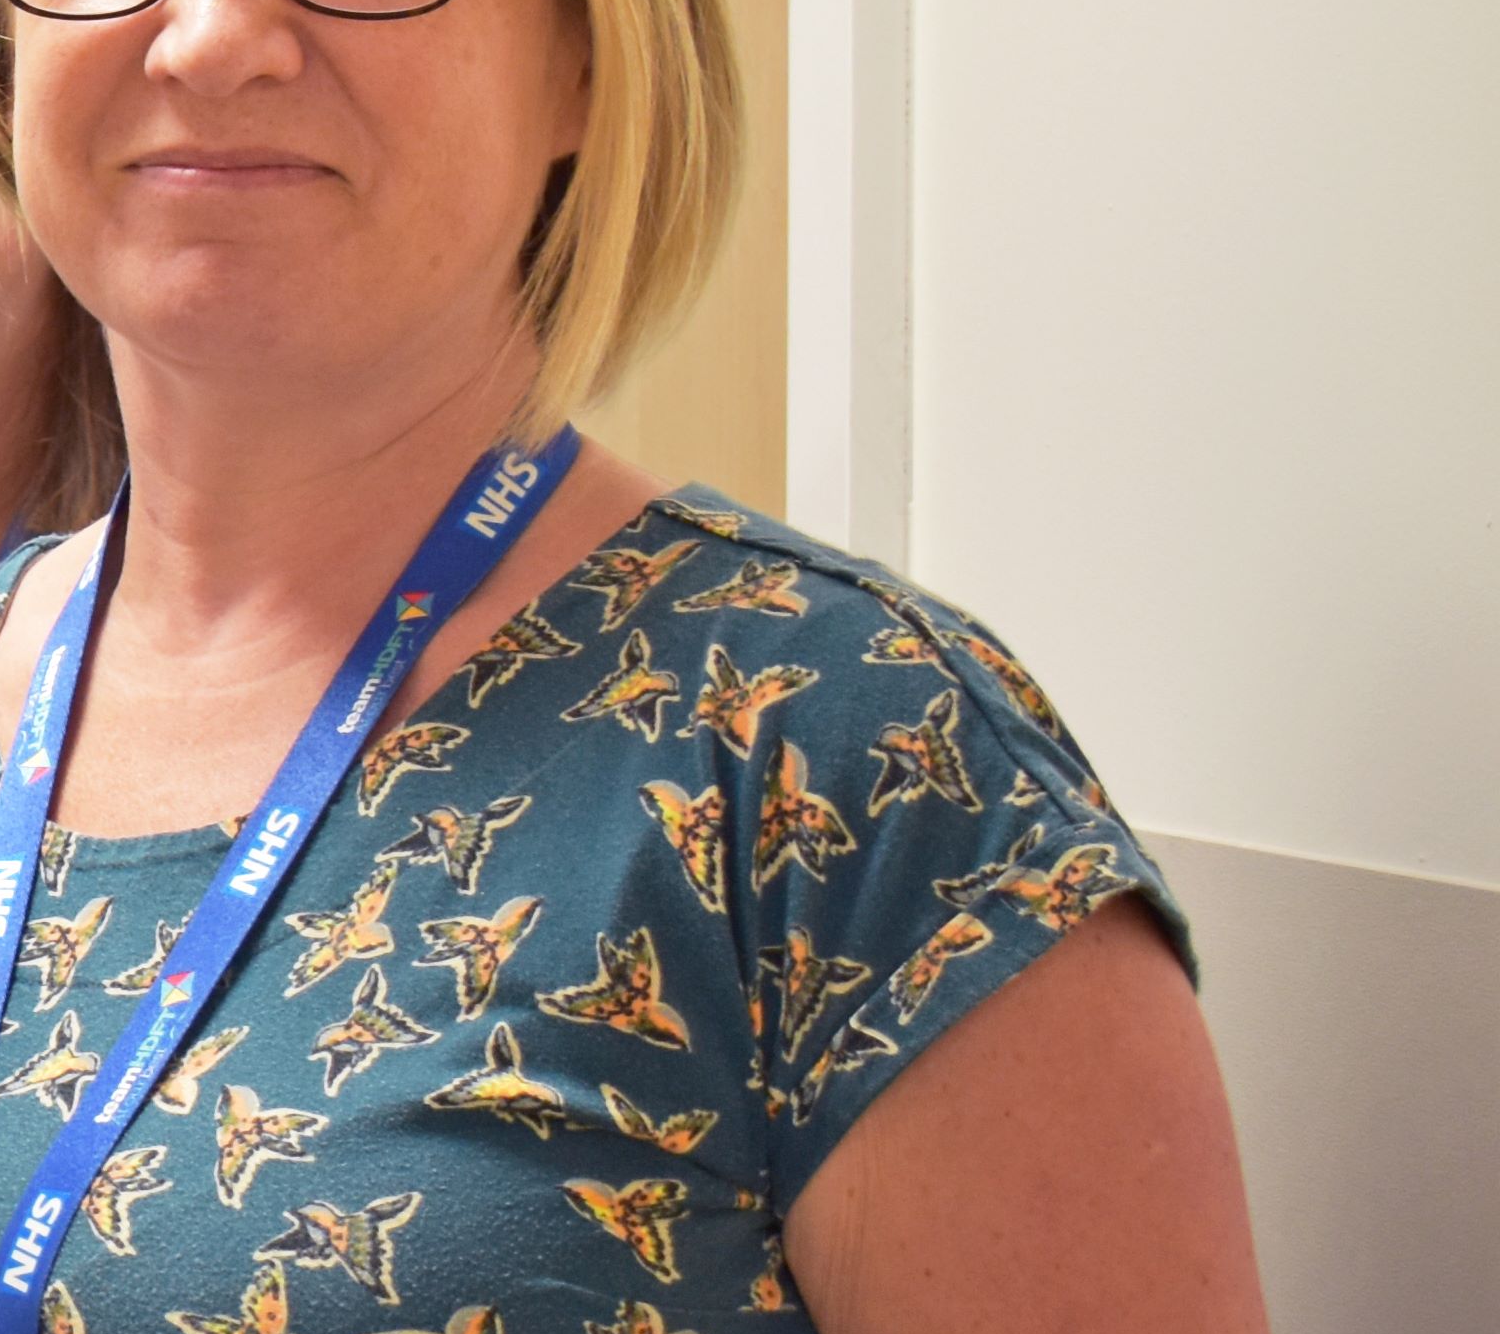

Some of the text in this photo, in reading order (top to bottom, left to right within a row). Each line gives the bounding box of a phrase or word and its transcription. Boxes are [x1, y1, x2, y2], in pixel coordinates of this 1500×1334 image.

[464, 452, 539, 538] NHS
[337, 623, 413, 734] teamHDFT
[229, 809, 300, 895] NHS
[94, 1007, 176, 1123] teamHDFT
[3, 1192, 61, 1294] NHS
